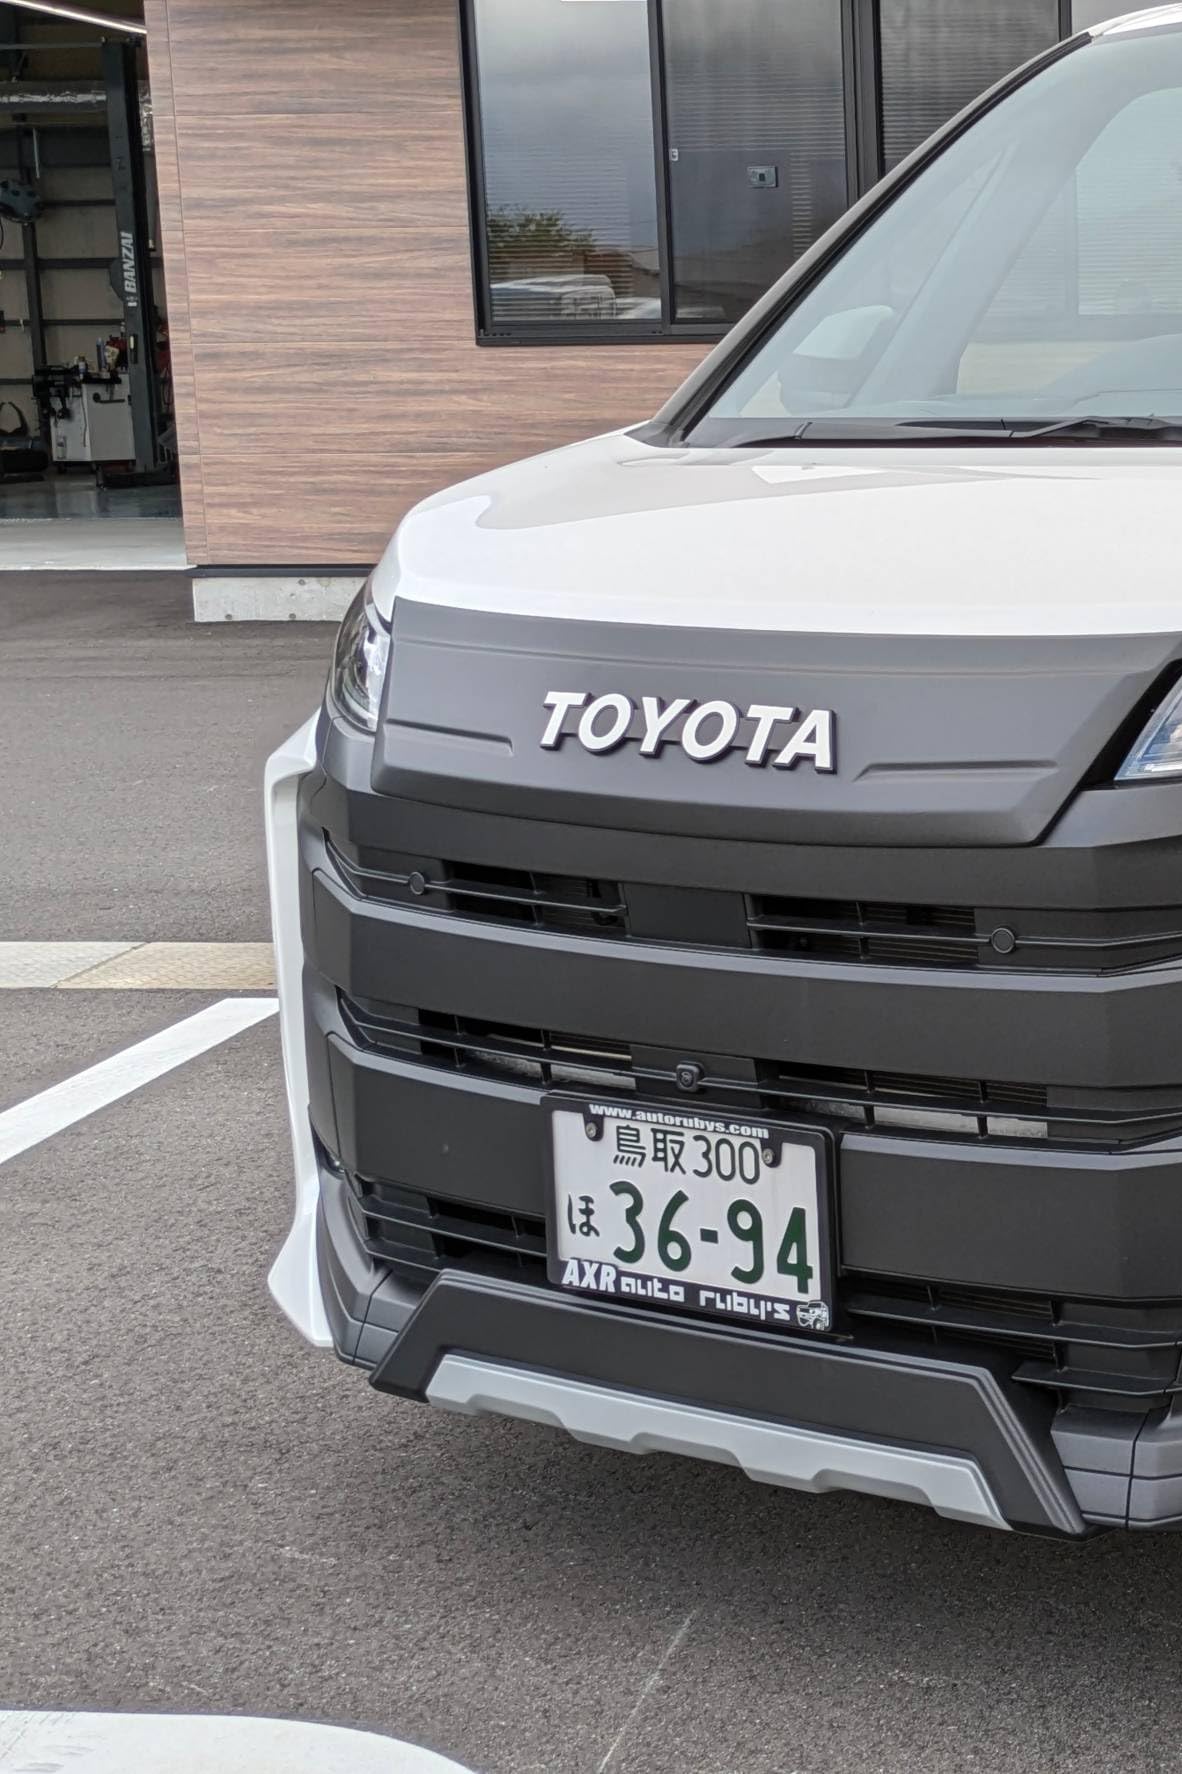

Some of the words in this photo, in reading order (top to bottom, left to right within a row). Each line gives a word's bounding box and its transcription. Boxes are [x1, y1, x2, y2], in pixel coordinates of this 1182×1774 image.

[120, 232, 136, 293] BANZAI
[540, 691, 836, 773] TOYOTA
[589, 1103, 769, 1139] www.autorubys.com
[567, 1193, 600, 1237] ほ
[609, 1180, 813, 1294] 36-94
[562, 1258, 616, 1292] AXR
[620, 1276, 685, 1302] auto
